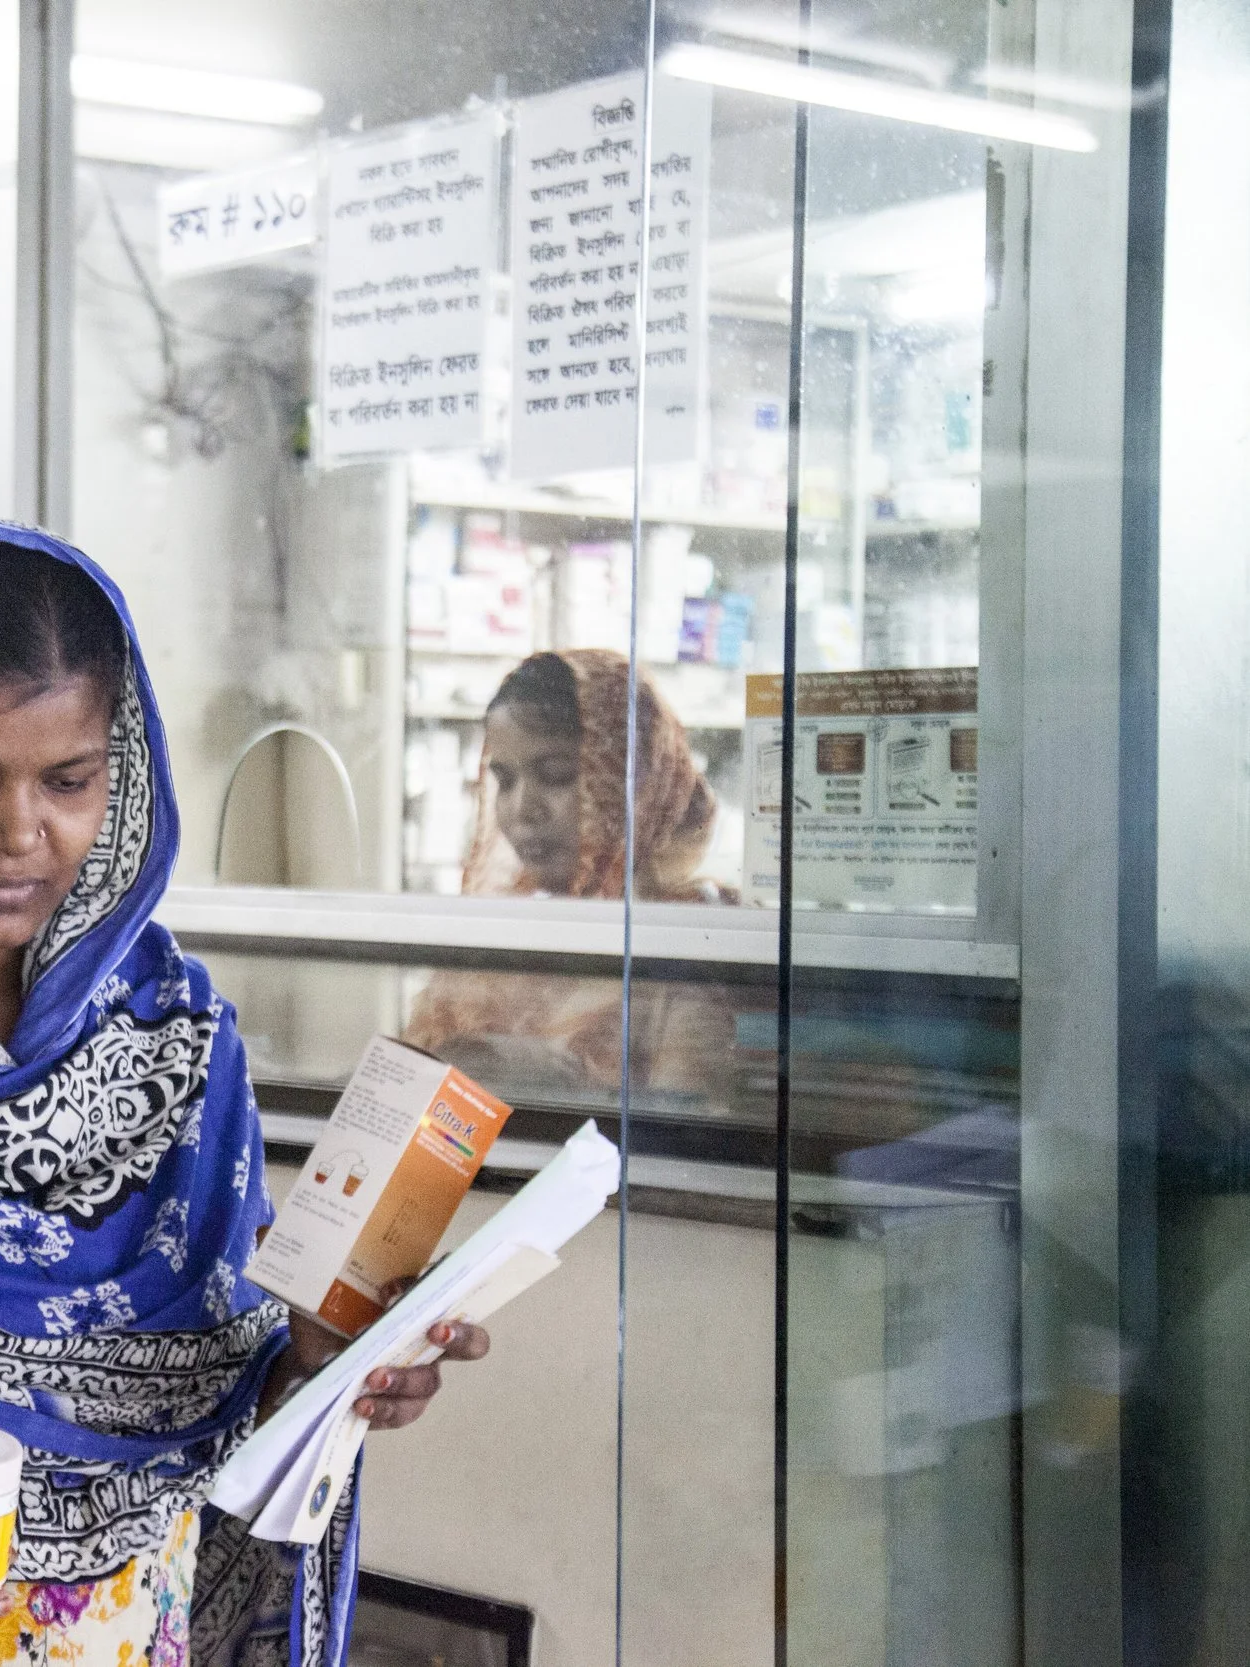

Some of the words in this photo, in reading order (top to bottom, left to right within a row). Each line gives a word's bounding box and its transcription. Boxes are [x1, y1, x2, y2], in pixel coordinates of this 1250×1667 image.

[530, 178, 589, 203] আপনাদের
[602, 170, 630, 190] সদয়
[649, 152, 692, 178] বগতির
[168, 206, 210, 246] রুম
[252, 192, 307, 232] ১১০
[568, 204, 613, 227] জানানো
[577, 229, 626, 257] ইনসুলিন
[529, 268, 577, 294] পরিবর্তন
[580, 267, 604, 287] করা
[607, 263, 625, 282] হয়
[376, 352, 433, 386] ইনসুলিন
[438, 351, 481, 377] ফেরত
[348, 396, 402, 425] পরিবর্তন
[407, 397, 434, 418] করা
[438, 395, 459, 416] হয়
[463, 391, 480, 412] না
[433, 1100, 479, 1141] Citra-K
